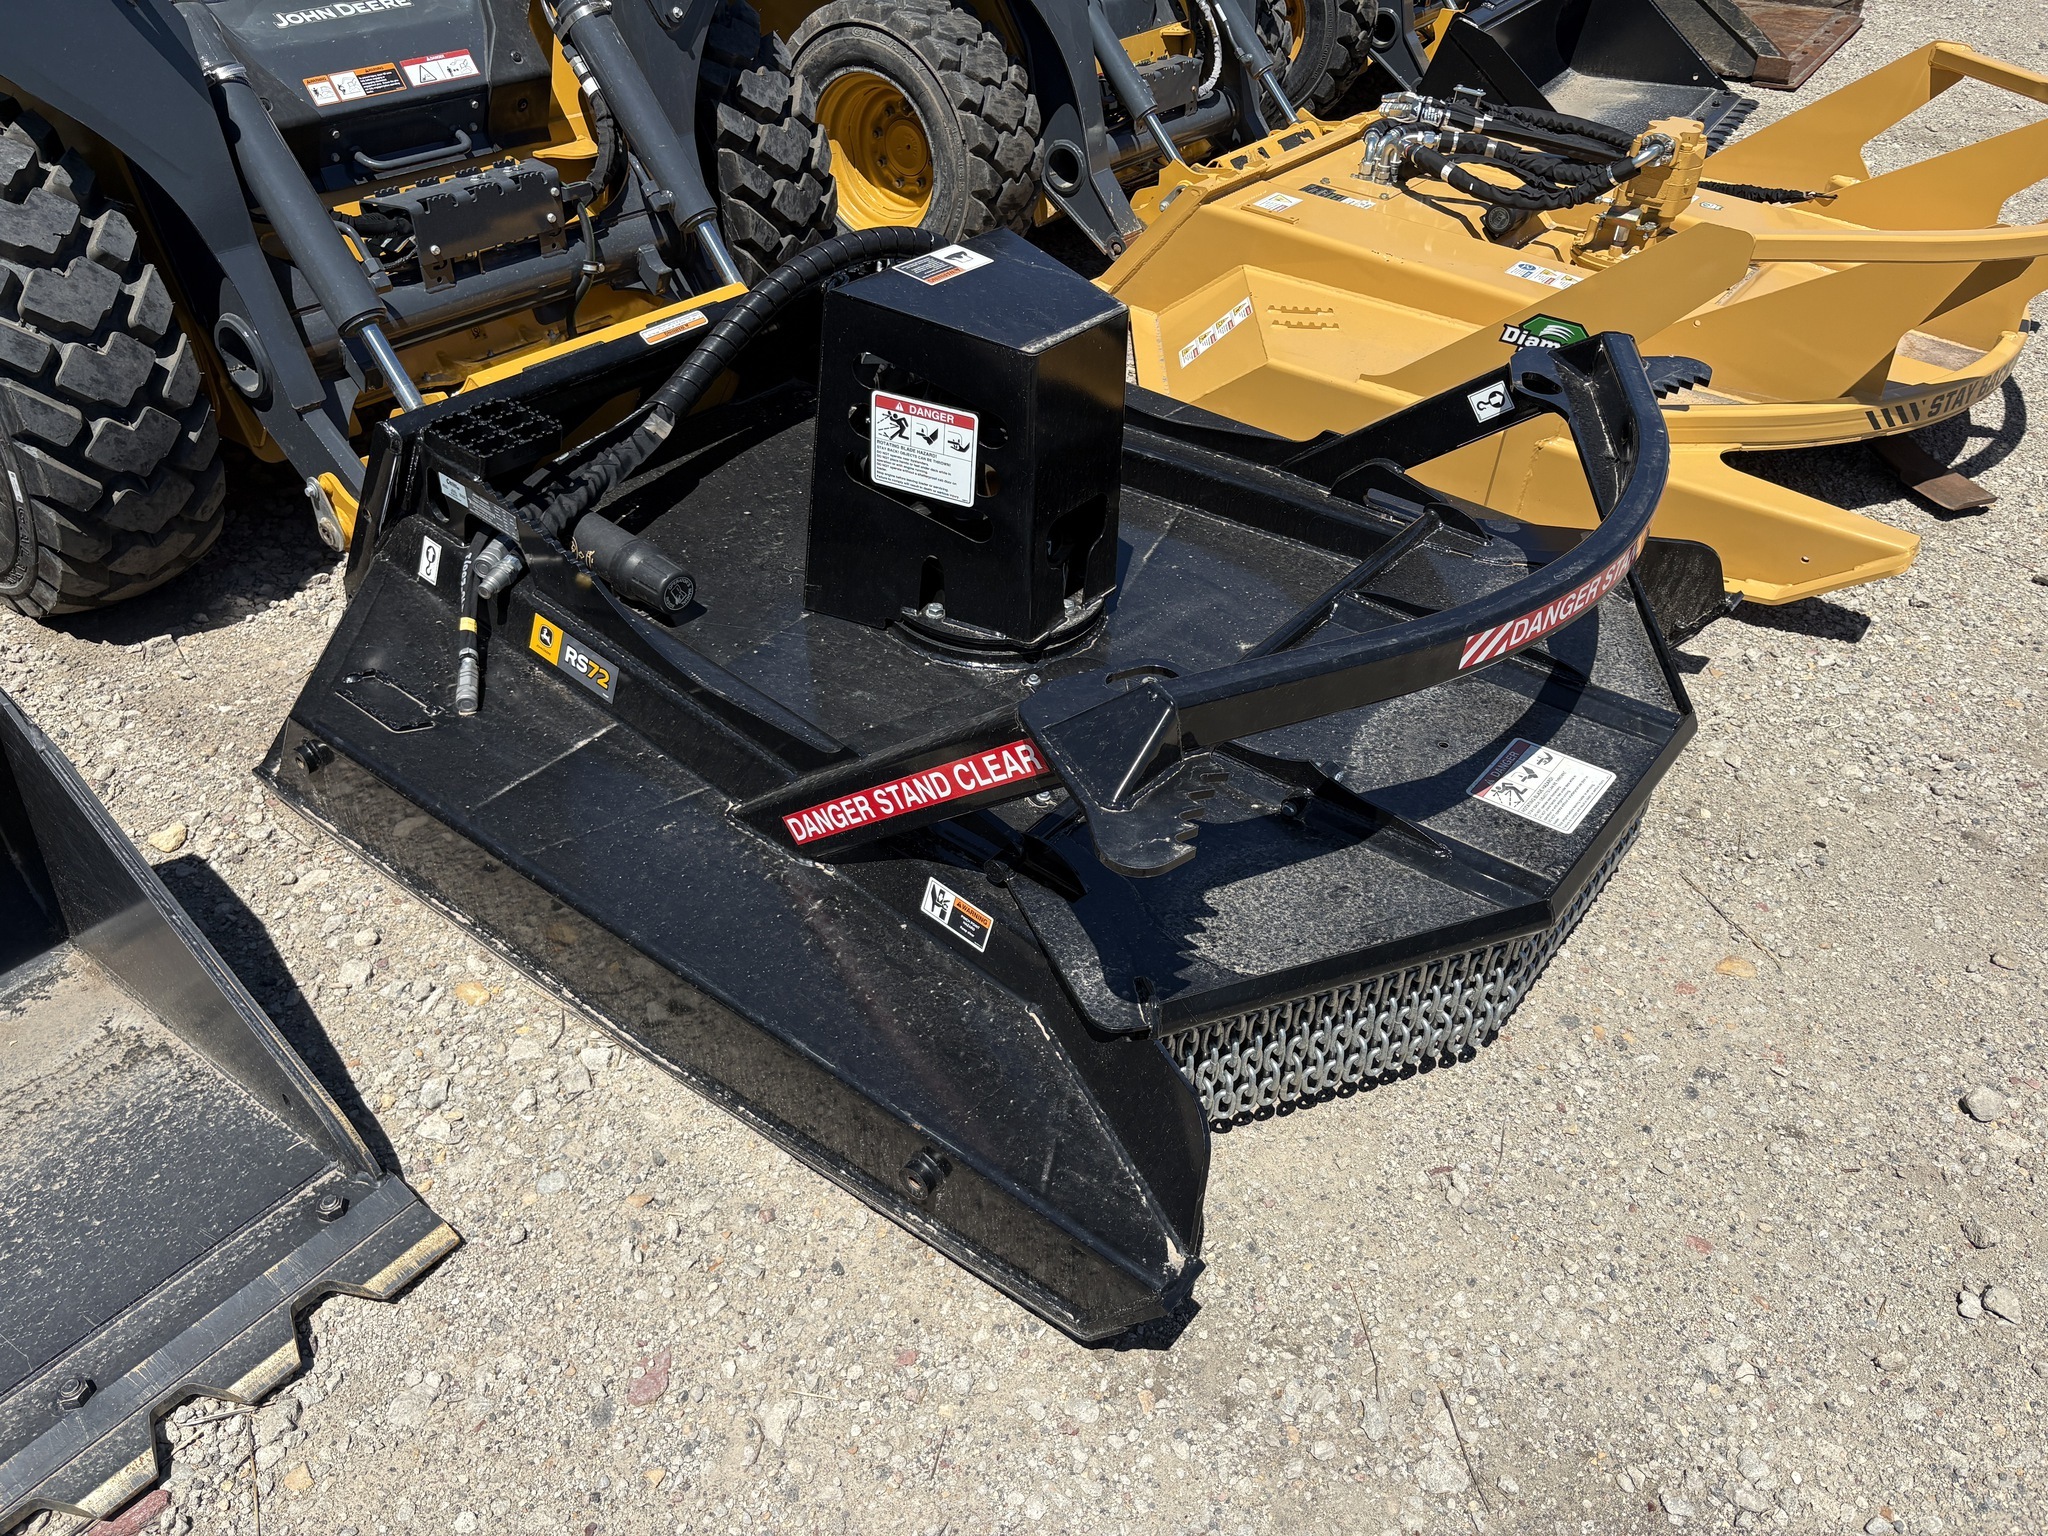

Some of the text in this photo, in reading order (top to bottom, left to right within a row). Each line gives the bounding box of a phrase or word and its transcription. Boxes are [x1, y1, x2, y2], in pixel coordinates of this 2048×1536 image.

[275, 8, 337, 27] JOHN
[851, 26, 926, 73] GALAXY
[1501, 326, 1561, 349] Diam
[1928, 381, 1980, 418] STAY
[909, 405, 955, 424] DANGER
[876, 439, 899, 449] ROTATING
[900, 445, 915, 453] BLADE
[1509, 575, 1602, 647] DANGER
[564, 644, 611, 691] RS72
[1490, 750, 1520, 778] DANGER
[786, 744, 1043, 842] DANGER STAND CLEAR
[962, 904, 988, 926] WARNING
